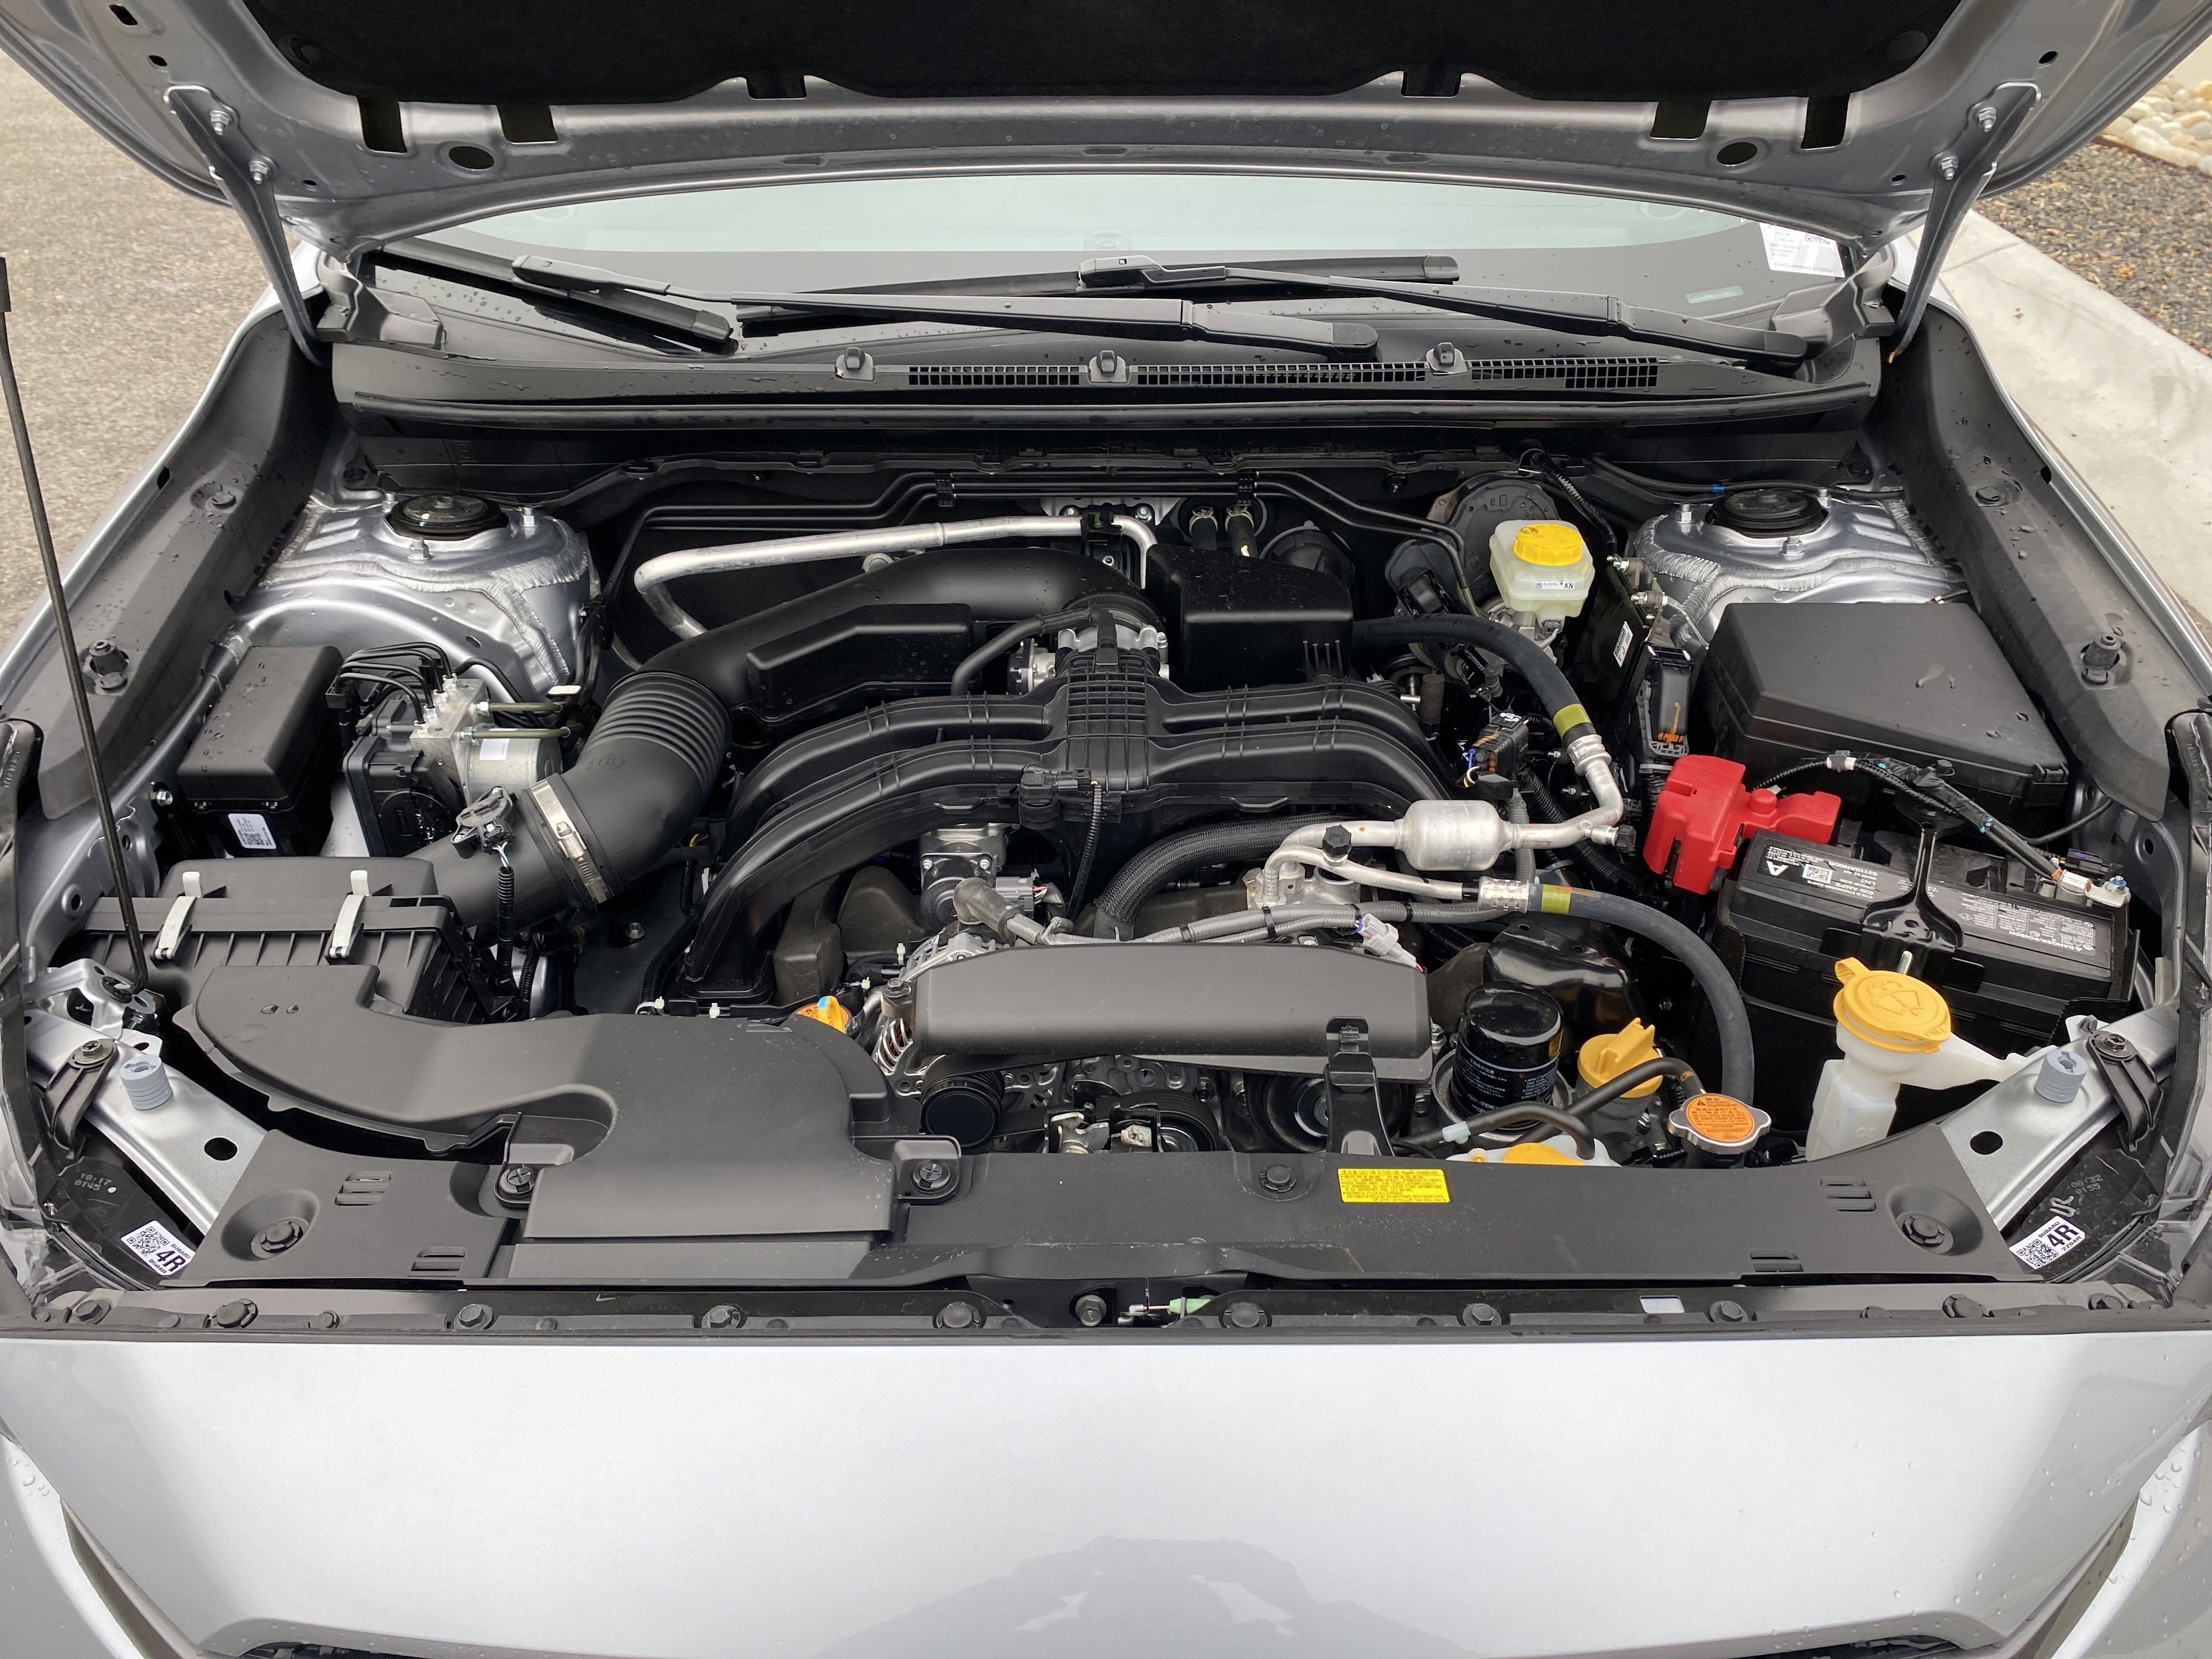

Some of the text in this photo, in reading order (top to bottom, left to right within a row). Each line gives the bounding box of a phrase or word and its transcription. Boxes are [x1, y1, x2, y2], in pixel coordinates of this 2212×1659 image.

[1829, 861, 1878, 876] 82110AN00B
[1825, 884, 1855, 895] CRANKING
[1835, 882, 1858, 891] AMPS
[2008, 930, 2074, 950] DANGER/POISON
[2038, 1221, 2060, 1238] SUBARU
[2047, 1224, 2079, 1247] 4R
[171, 1244, 191, 1259] SUBARU
[155, 1250, 186, 1272] 4R
